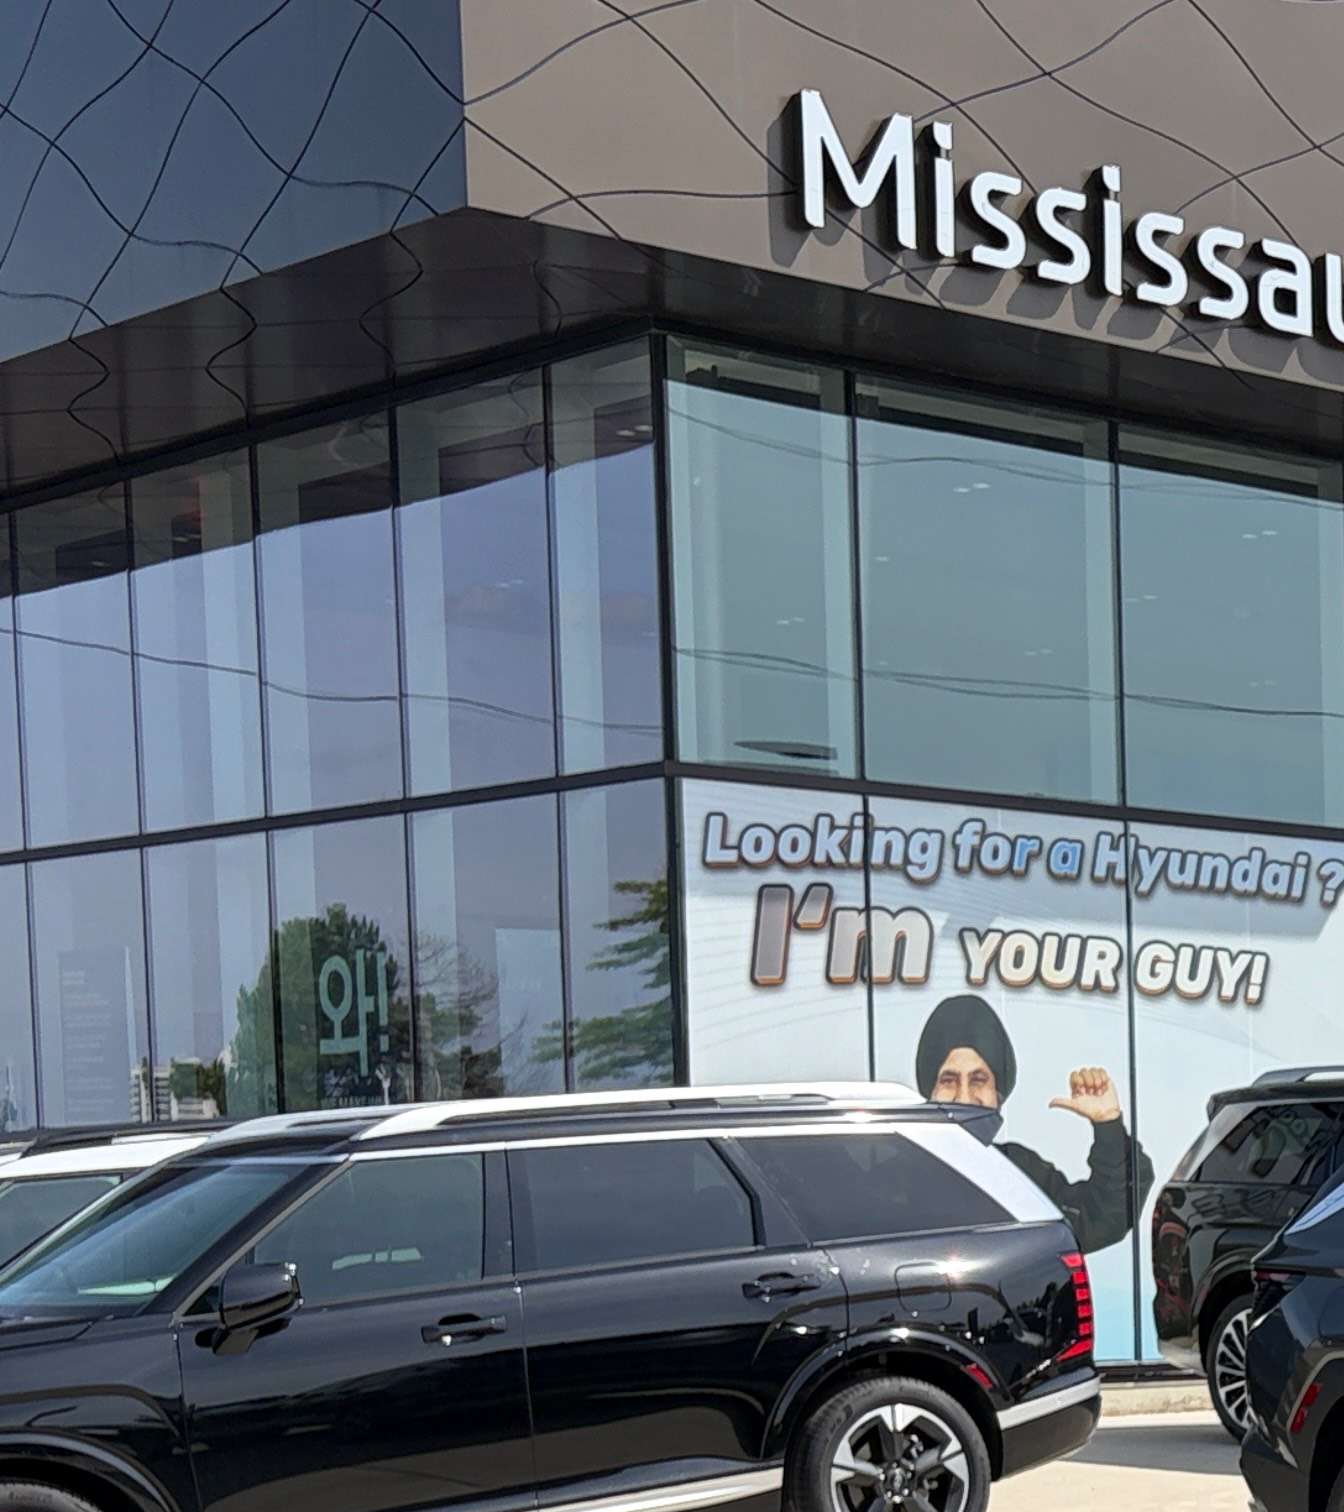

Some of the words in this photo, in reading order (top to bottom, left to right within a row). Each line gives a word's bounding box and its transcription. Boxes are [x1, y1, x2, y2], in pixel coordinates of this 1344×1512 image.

[702, 810, 944, 884] Looking
[951, 817, 1042, 876] for
[1046, 837, 1085, 880] a
[1091, 831, 1310, 905] Hyundai
[748, 882, 936, 988] I'm
[956, 924, 1123, 994] YOUR
[1133, 938, 1270, 1006] GUY!
